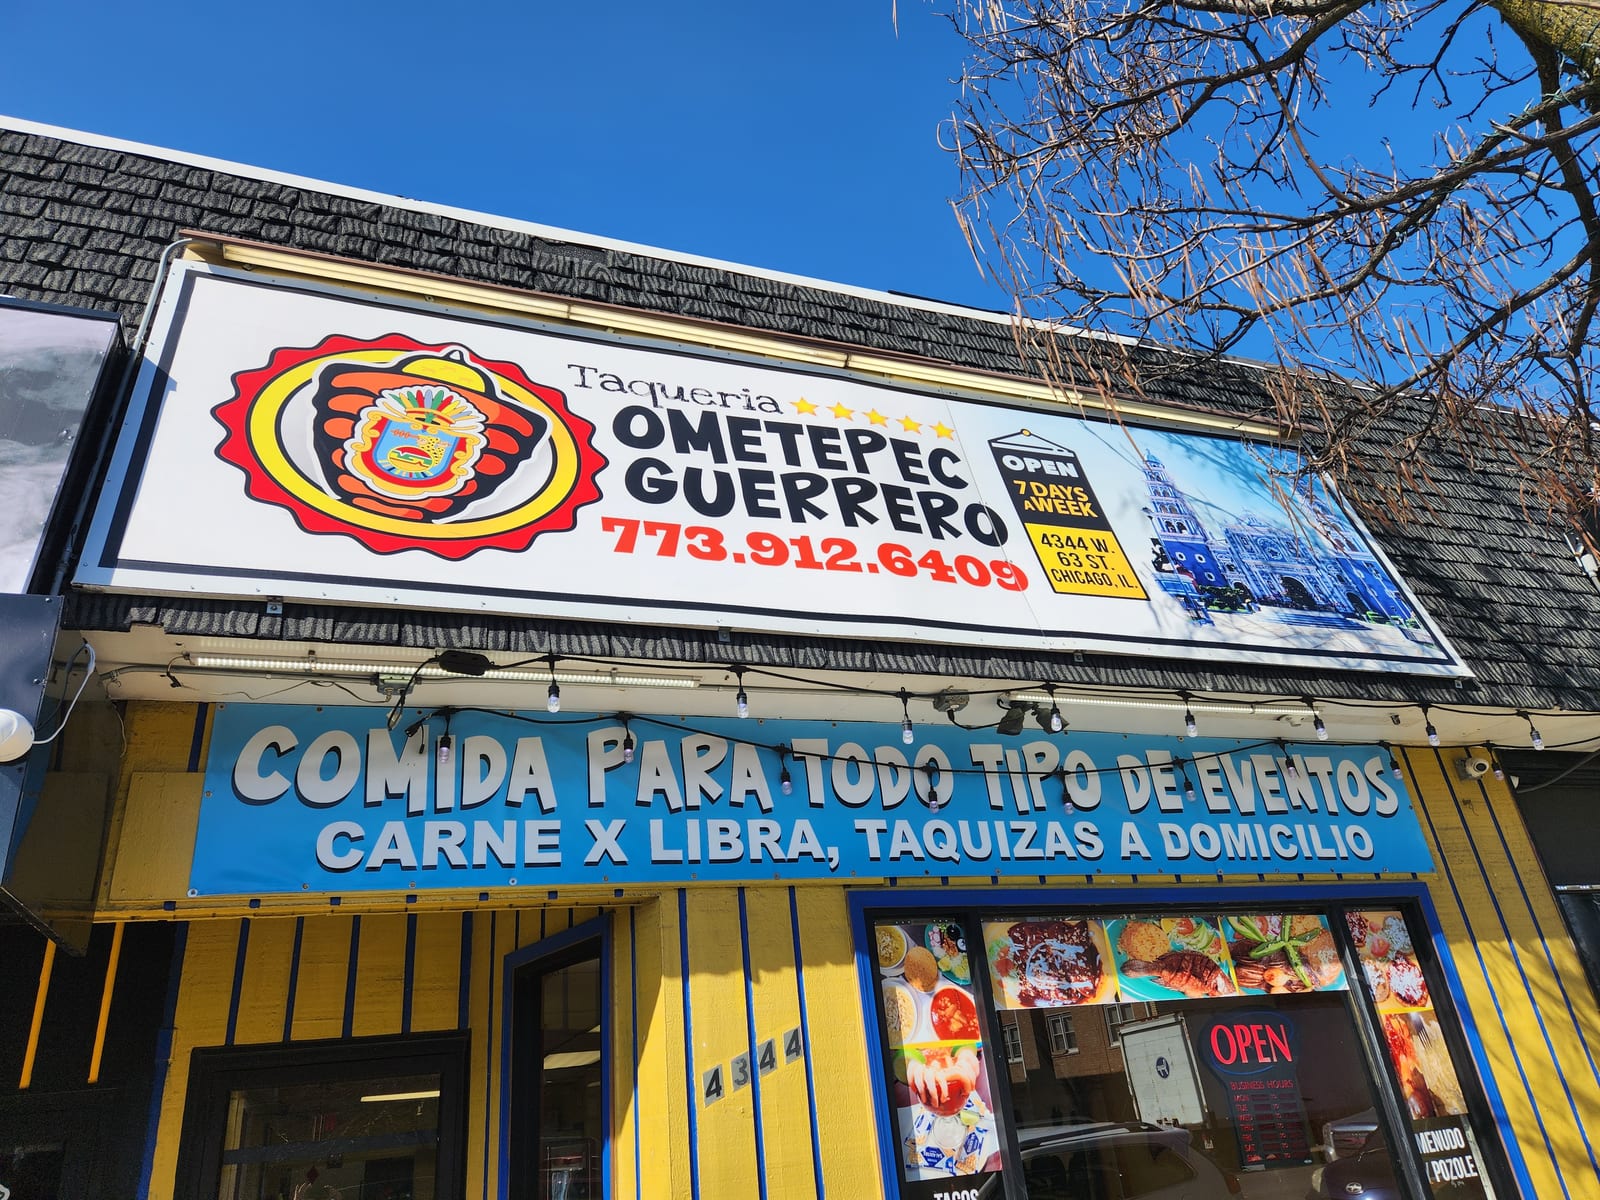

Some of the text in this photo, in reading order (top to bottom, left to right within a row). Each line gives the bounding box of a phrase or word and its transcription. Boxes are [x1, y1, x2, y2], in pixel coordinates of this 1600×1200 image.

[567, 364, 784, 414] Taqueria
[612, 405, 969, 489] OMETEPEC
[1002, 455, 1079, 478] OPEN
[624, 457, 1009, 547] GUERRERO
[1013, 480, 1089, 502] 7 DAYS
[1030, 496, 1098, 518] WEEK
[600, 516, 1028, 592] 773.912.6409
[1041, 533, 1115, 554] 4344 W.
[1057, 552, 1115, 570] 63 ST.
[1050, 569, 1138, 589] CHICAGO, IL.
[232, 725, 1399, 817] COMIDA PARA TODO TIPO DE EVENTOS
[315, 818, 1375, 873] CARNE X LIBRA, TAQUIZAS A DOMICILIO
[1210, 1024, 1293, 1065] OPEN
[1230, 1079, 1294, 1091] BUSINESS HOURS
[1414, 1127, 1465, 1154] MENUDO
[1431, 1155, 1478, 1183] POZOLE
